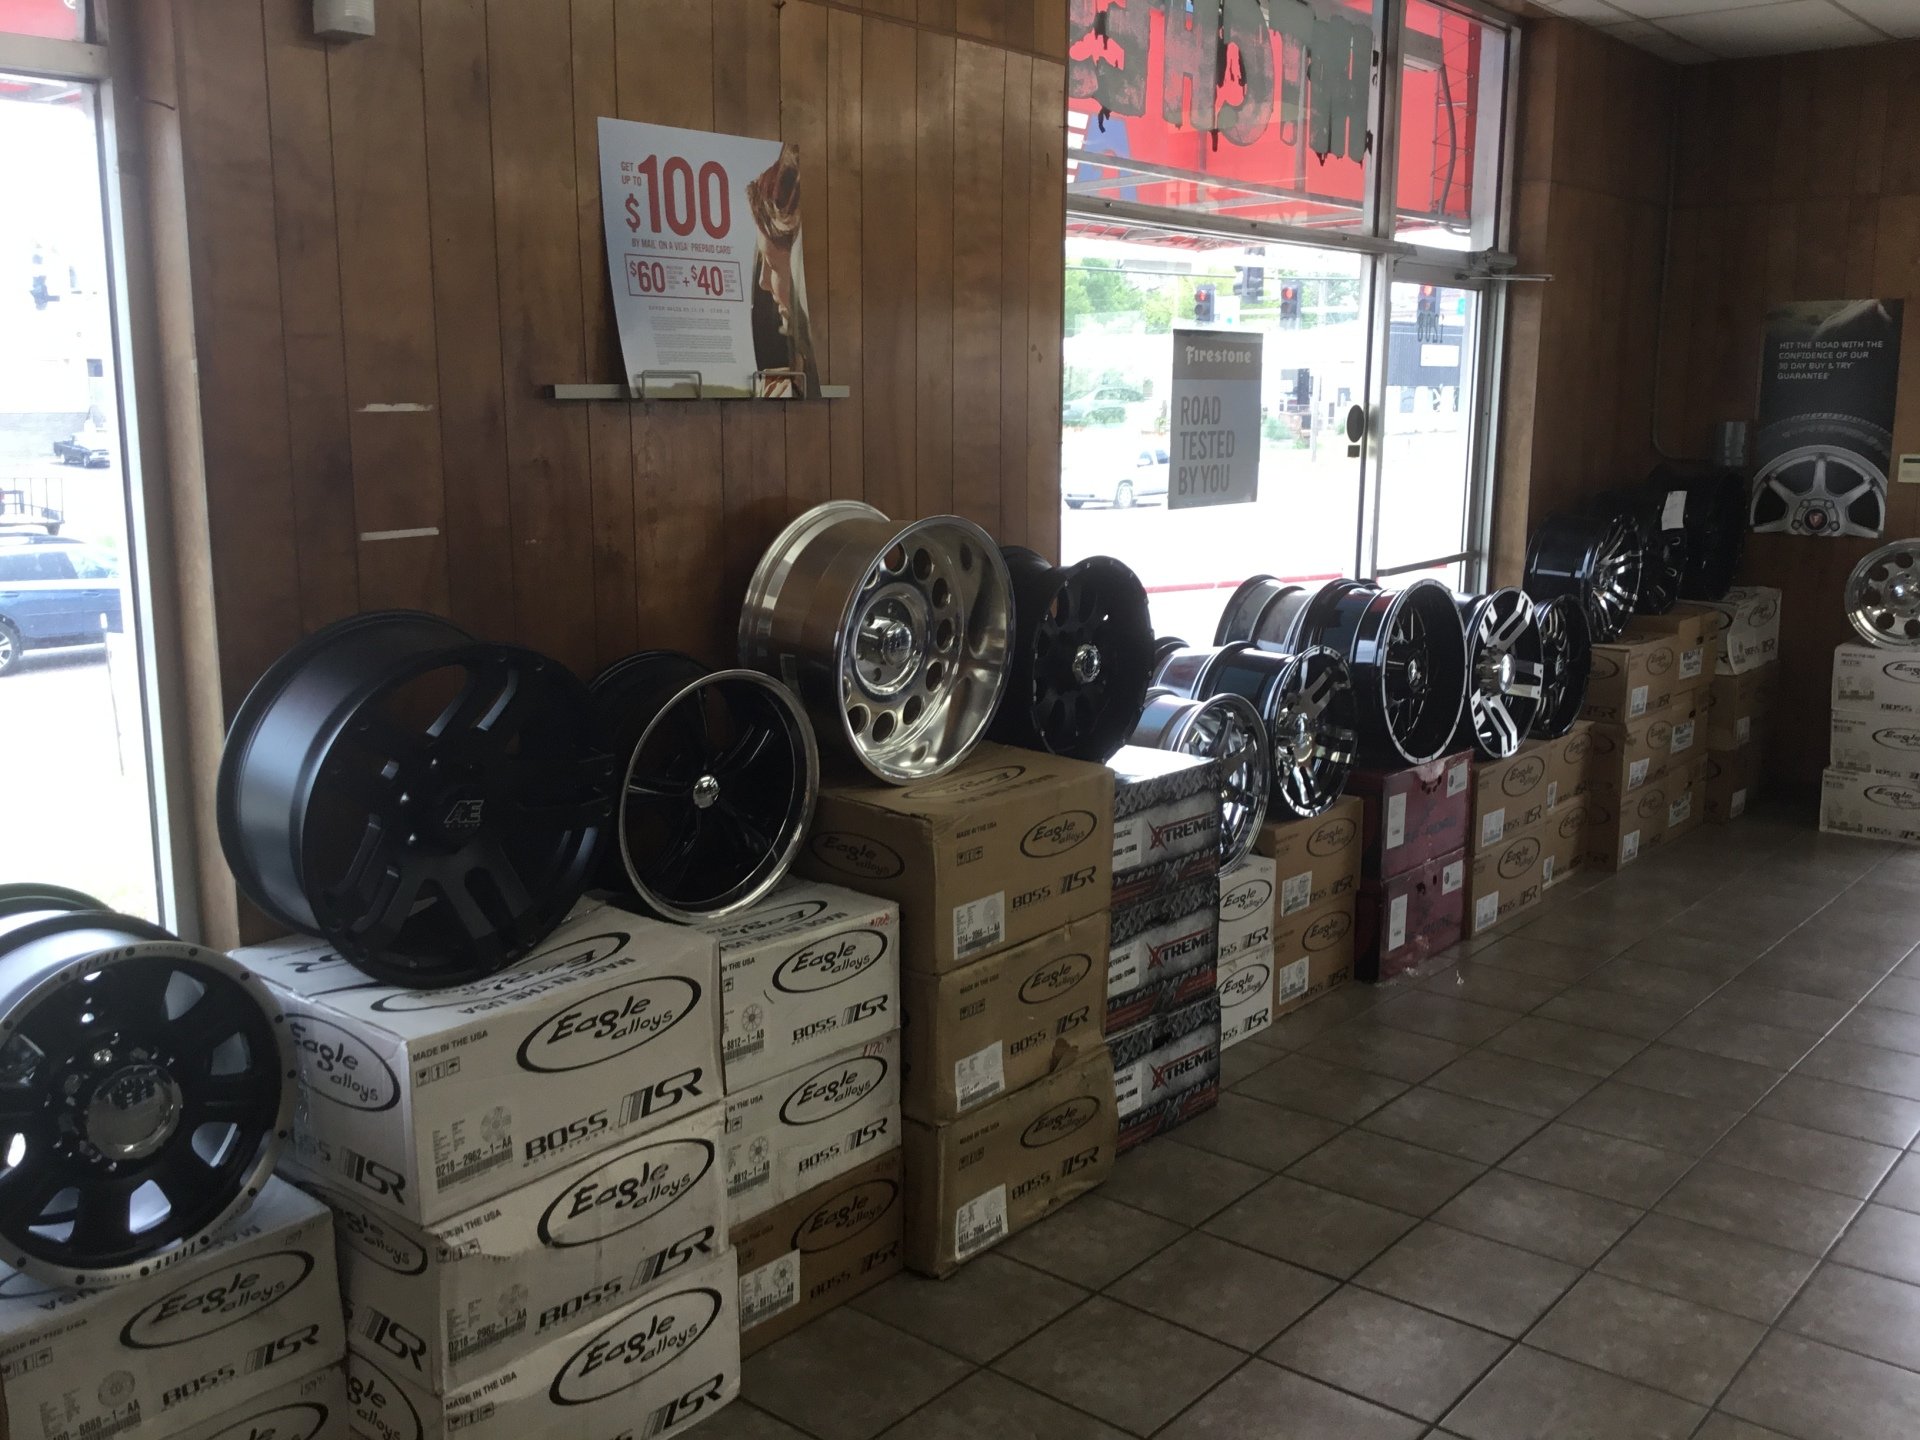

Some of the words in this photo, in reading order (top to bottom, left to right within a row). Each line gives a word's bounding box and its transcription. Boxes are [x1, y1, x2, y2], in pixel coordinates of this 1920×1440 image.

[621, 161, 634, 172] GET
[621, 175, 631, 185] UP
[632, 175, 642, 187] TO
[631, 238, 640, 248] BY
[658, 240, 668, 249] ON
[691, 243, 714, 254] PREPAID
[629, 260, 666, 293] $60
[690, 265, 724, 297] $40
[1185, 345, 1252, 365] Firestone
[1778, 351, 1834, 360] CONFIDENCE
[1836, 351, 1849, 359] OF
[1850, 351, 1869, 359] OUR
[1779, 341, 1795, 350] HIT
[1796, 341, 1813, 350] THE
[1815, 341, 1840, 349] ROAD
[1841, 340, 1864, 349] WITH
[1866, 340, 1884, 349] THE
[1790, 362, 1807, 370] DAY
[1808, 362, 1826, 370] BUY
[1180, 396, 1221, 427] ROAD
[1179, 430, 1235, 461] TESTED
[1178, 465, 1198, 496] BY
[1200, 464, 1231, 494] YOU
[957, 829, 972, 840] MADE
[1032, 819, 1077, 842] Eagle
[825, 835, 877, 864] Eagle
[1012, 885, 1051, 909] BOSS
[1223, 887, 1257, 908] Eagle
[728, 960, 741, 971] THE
[742, 956, 756, 967] USA
[791, 942, 857, 974] Eagle
[831, 953, 871, 974] alloys
[1030, 963, 1073, 989] Eagle
[1222, 972, 1255, 995] Eagle
[546, 996, 651, 1045] Eagle
[611, 1008, 673, 1040] alloys
[792, 1014, 837, 1041] BOSS
[412, 1047, 438, 1063] MADE
[440, 1044, 450, 1055] IN
[451, 1036, 469, 1052] THE
[470, 1030, 489, 1046] USA
[1010, 1029, 1047, 1056] BOSS
[330, 1071, 379, 1101] alloys
[797, 1069, 858, 1107] Eagle
[834, 1080, 871, 1102] alloys
[525, 1108, 609, 1161] BOSS
[798, 1143, 840, 1173] BOSS
[567, 1161, 670, 1219] Eagle
[632, 1172, 691, 1210] alloys
[1012, 1170, 1051, 1201] BOSS
[454, 1224, 464, 1236] IN
[465, 1217, 483, 1232] THE
[483, 1208, 502, 1224] USA
[807, 1195, 870, 1235] Eagle
[149, 1271, 261, 1324] Eagle
[219, 1280, 286, 1314] alloys
[538, 1276, 622, 1330] BOSS
[577, 1313, 676, 1378] Eagle
[639, 1321, 699, 1364] alloys
[161, 1362, 237, 1405] BOSS
[445, 1394, 472, 1411] MADE
[472, 1389, 482, 1401] IN
[482, 1379, 499, 1397] THE
[499, 1370, 518, 1388] USA
